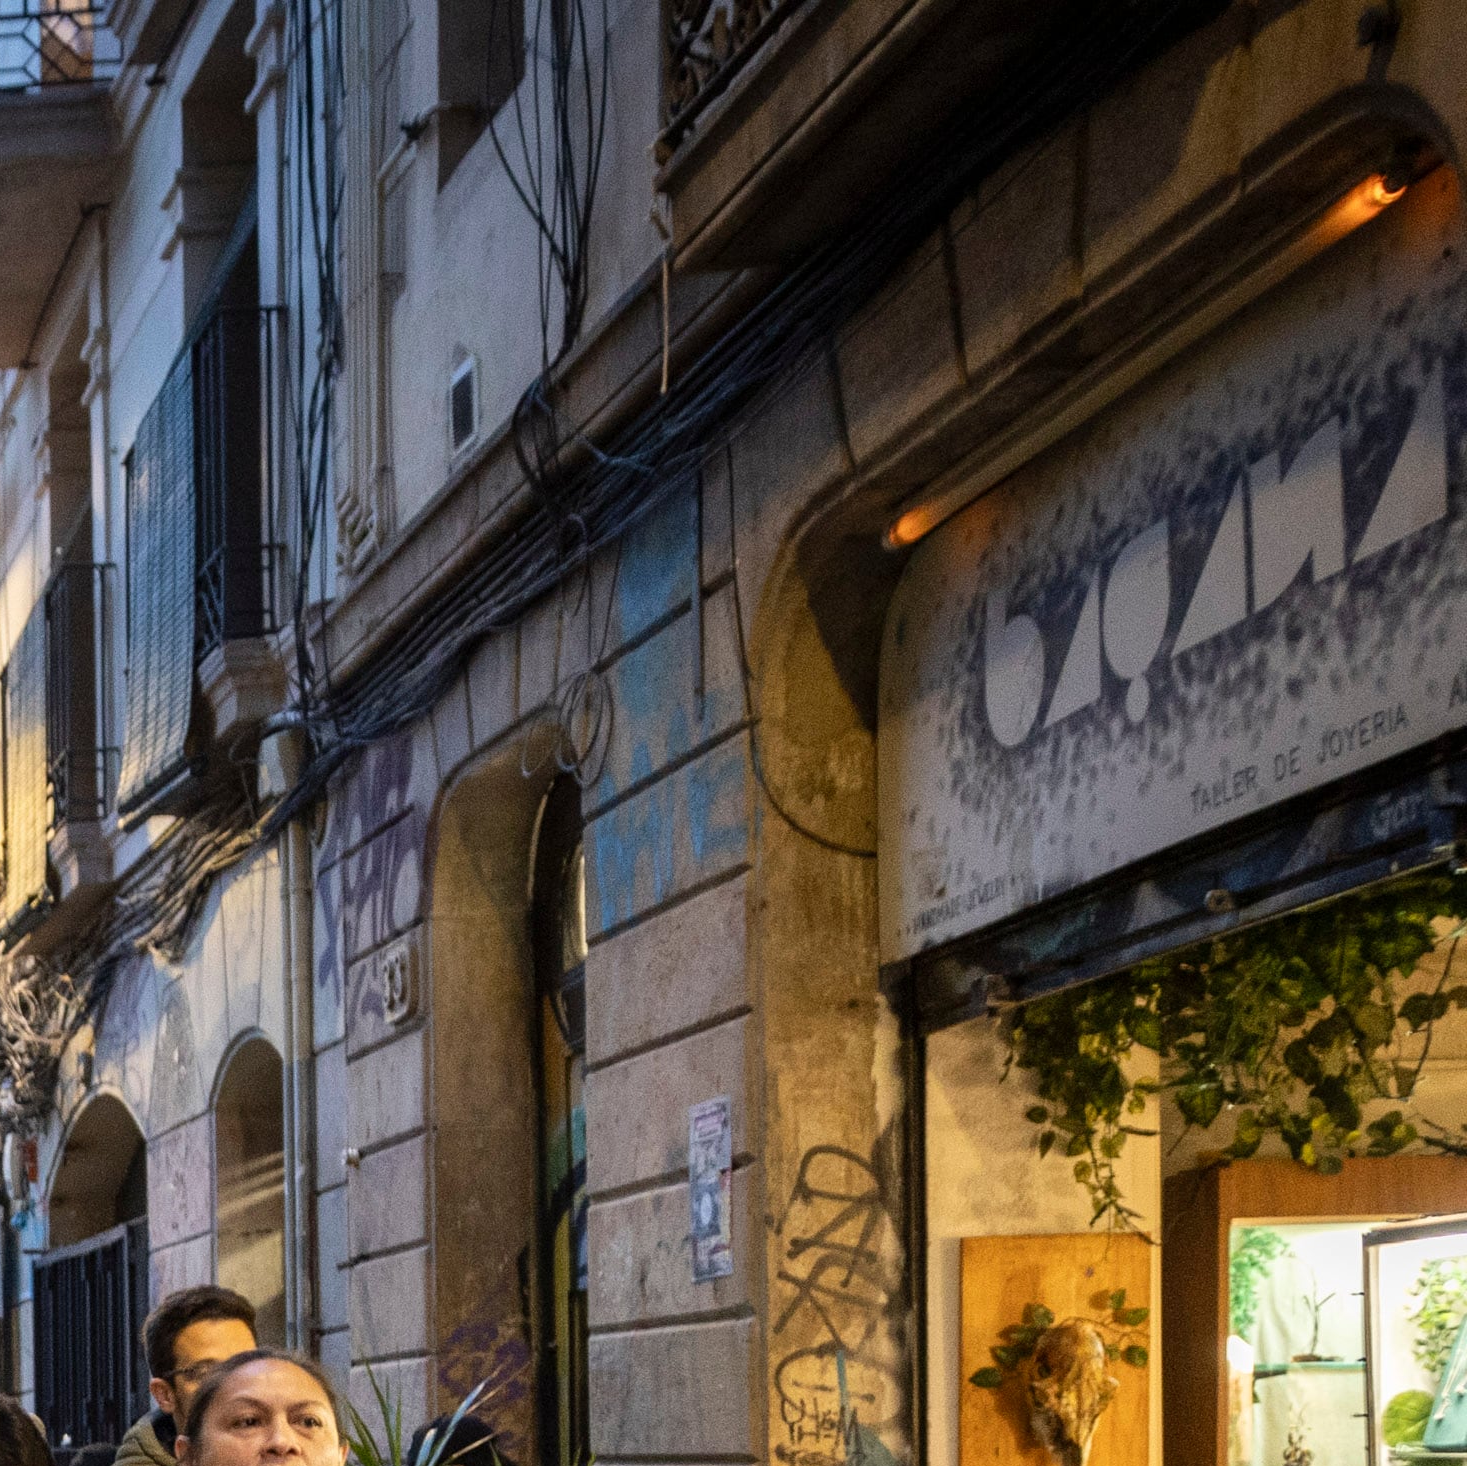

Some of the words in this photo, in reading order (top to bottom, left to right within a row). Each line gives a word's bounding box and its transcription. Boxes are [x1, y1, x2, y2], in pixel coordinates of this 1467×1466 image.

[1189, 764, 1259, 814] TALLER
[1272, 744, 1301, 783] DE
[1319, 701, 1409, 766] JOYERIA
